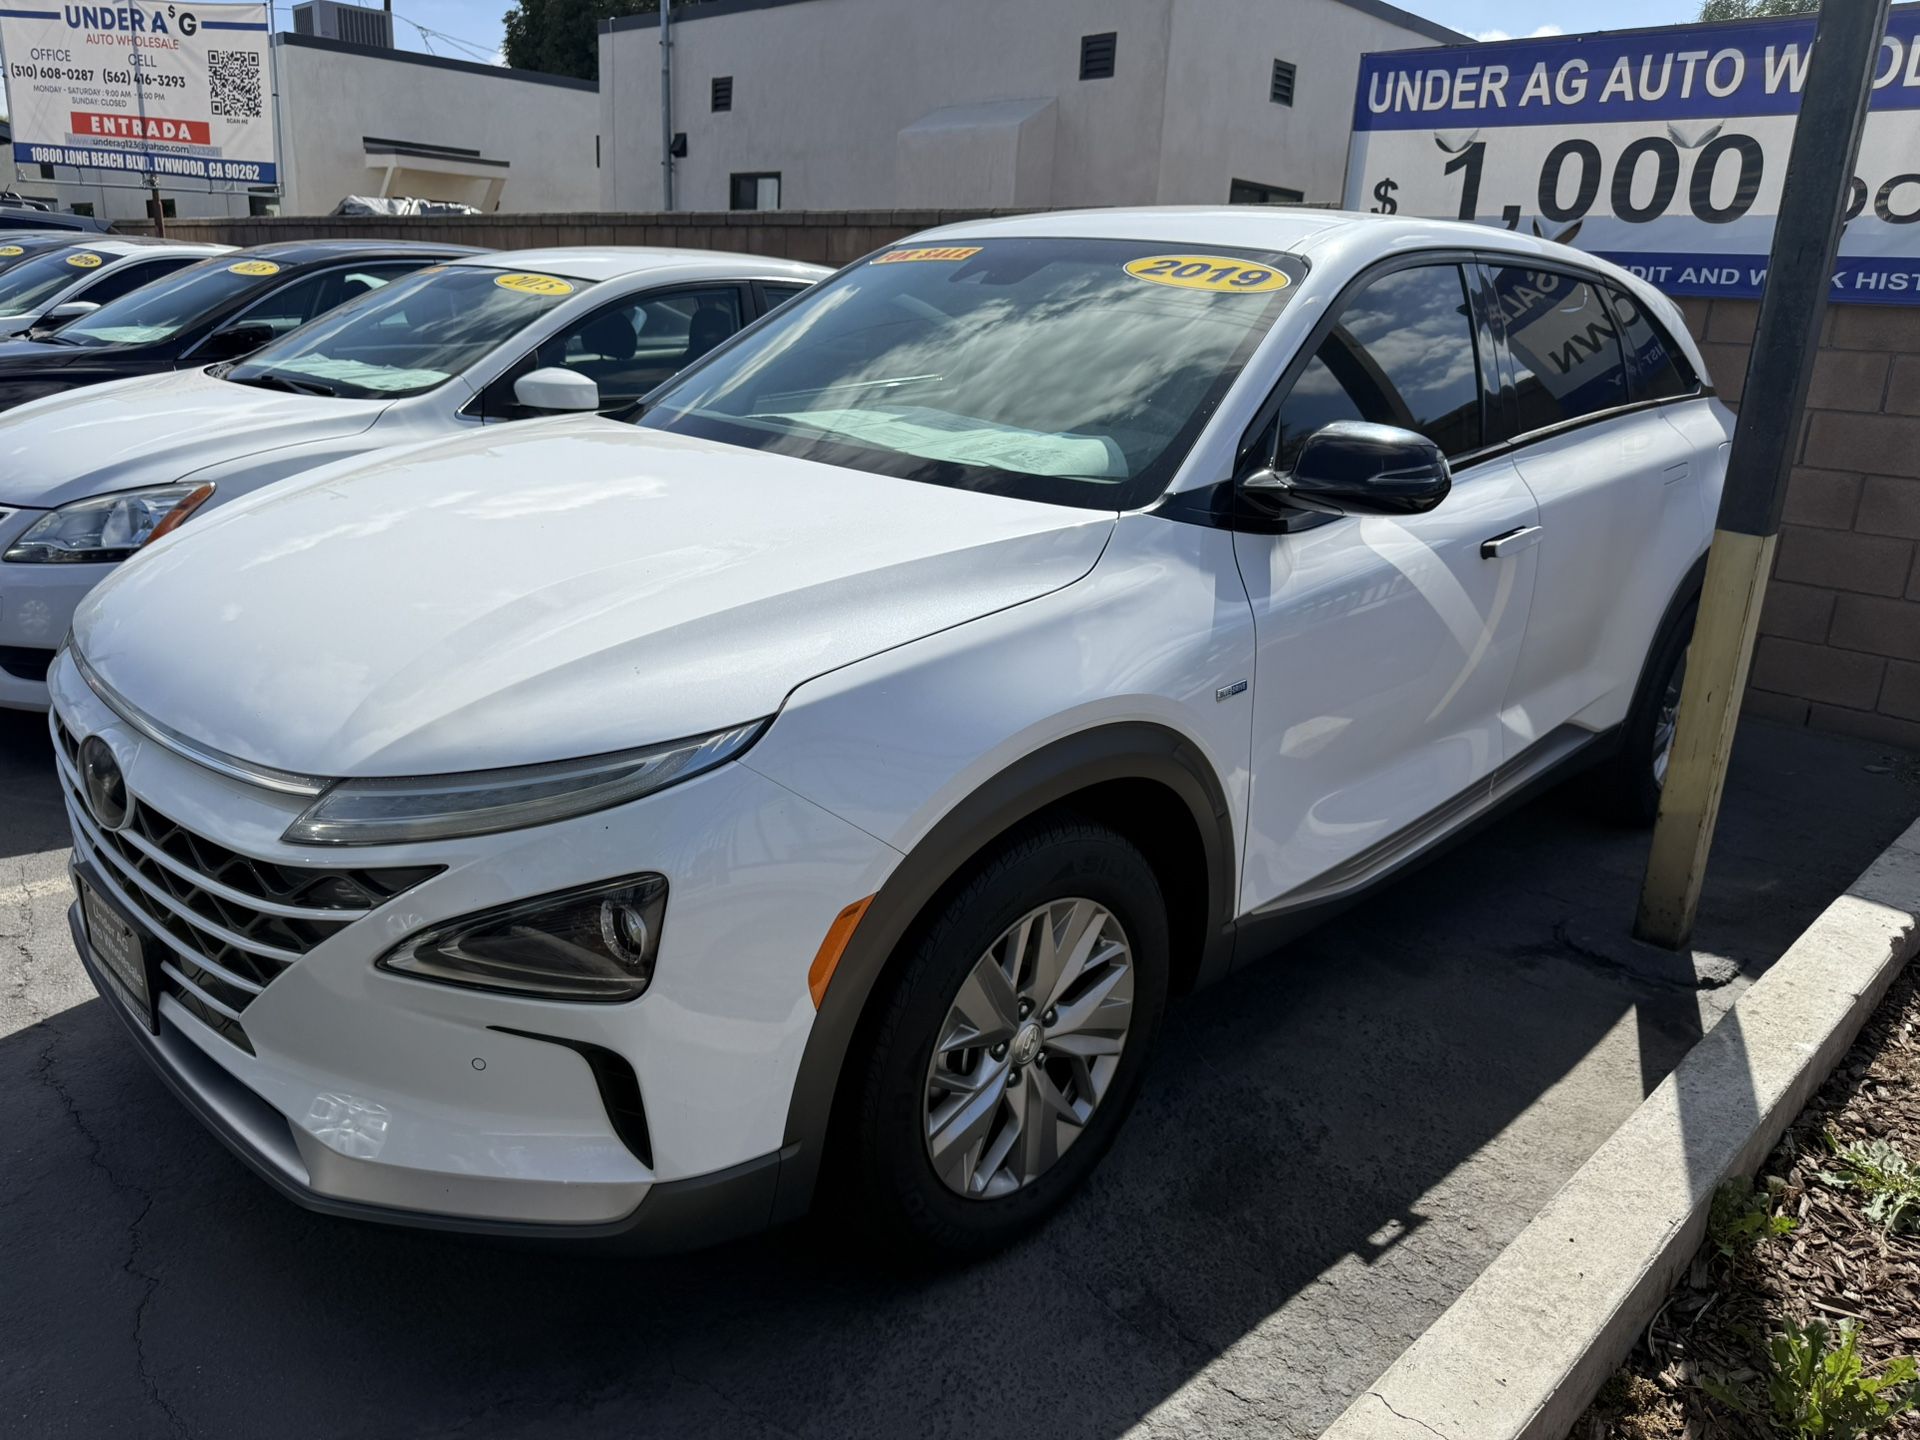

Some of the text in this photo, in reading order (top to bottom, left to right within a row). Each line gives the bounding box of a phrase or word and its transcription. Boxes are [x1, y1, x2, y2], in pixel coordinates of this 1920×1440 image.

[65, 5, 145, 32] UNDER
[86, 33, 179, 50] AUTO WHOLESALE
[31, 48, 71, 62] OFFICE
[128, 53, 157, 68] CELL
[11, 62, 94, 82] (310) 608-0287
[103, 68, 186, 88] (562) 416-3293
[1368, 64, 1509, 114] UNDER
[1519, 58, 1590, 107] AG
[1599, 48, 1745, 103] AUTO
[33, 84, 62, 93] MONDAY
[68, 87, 101, 96] SATURDAY
[101, 98, 127, 108] CLOSED
[91, 116, 192, 140] ENTRADA
[31, 147, 63, 163] 10800
[65, 149, 90, 166] LONG
[91, 151, 123, 168] BEACH
[154, 157, 207, 177] LYNWOOD,
[209, 163, 224, 178] CA
[225, 164, 260, 180] 90262
[1443, 134, 1764, 231] 1,000
[916, 248, 980, 259] SALE
[1136, 259, 1272, 287] 2019
[1677, 267, 1740, 286] AND
